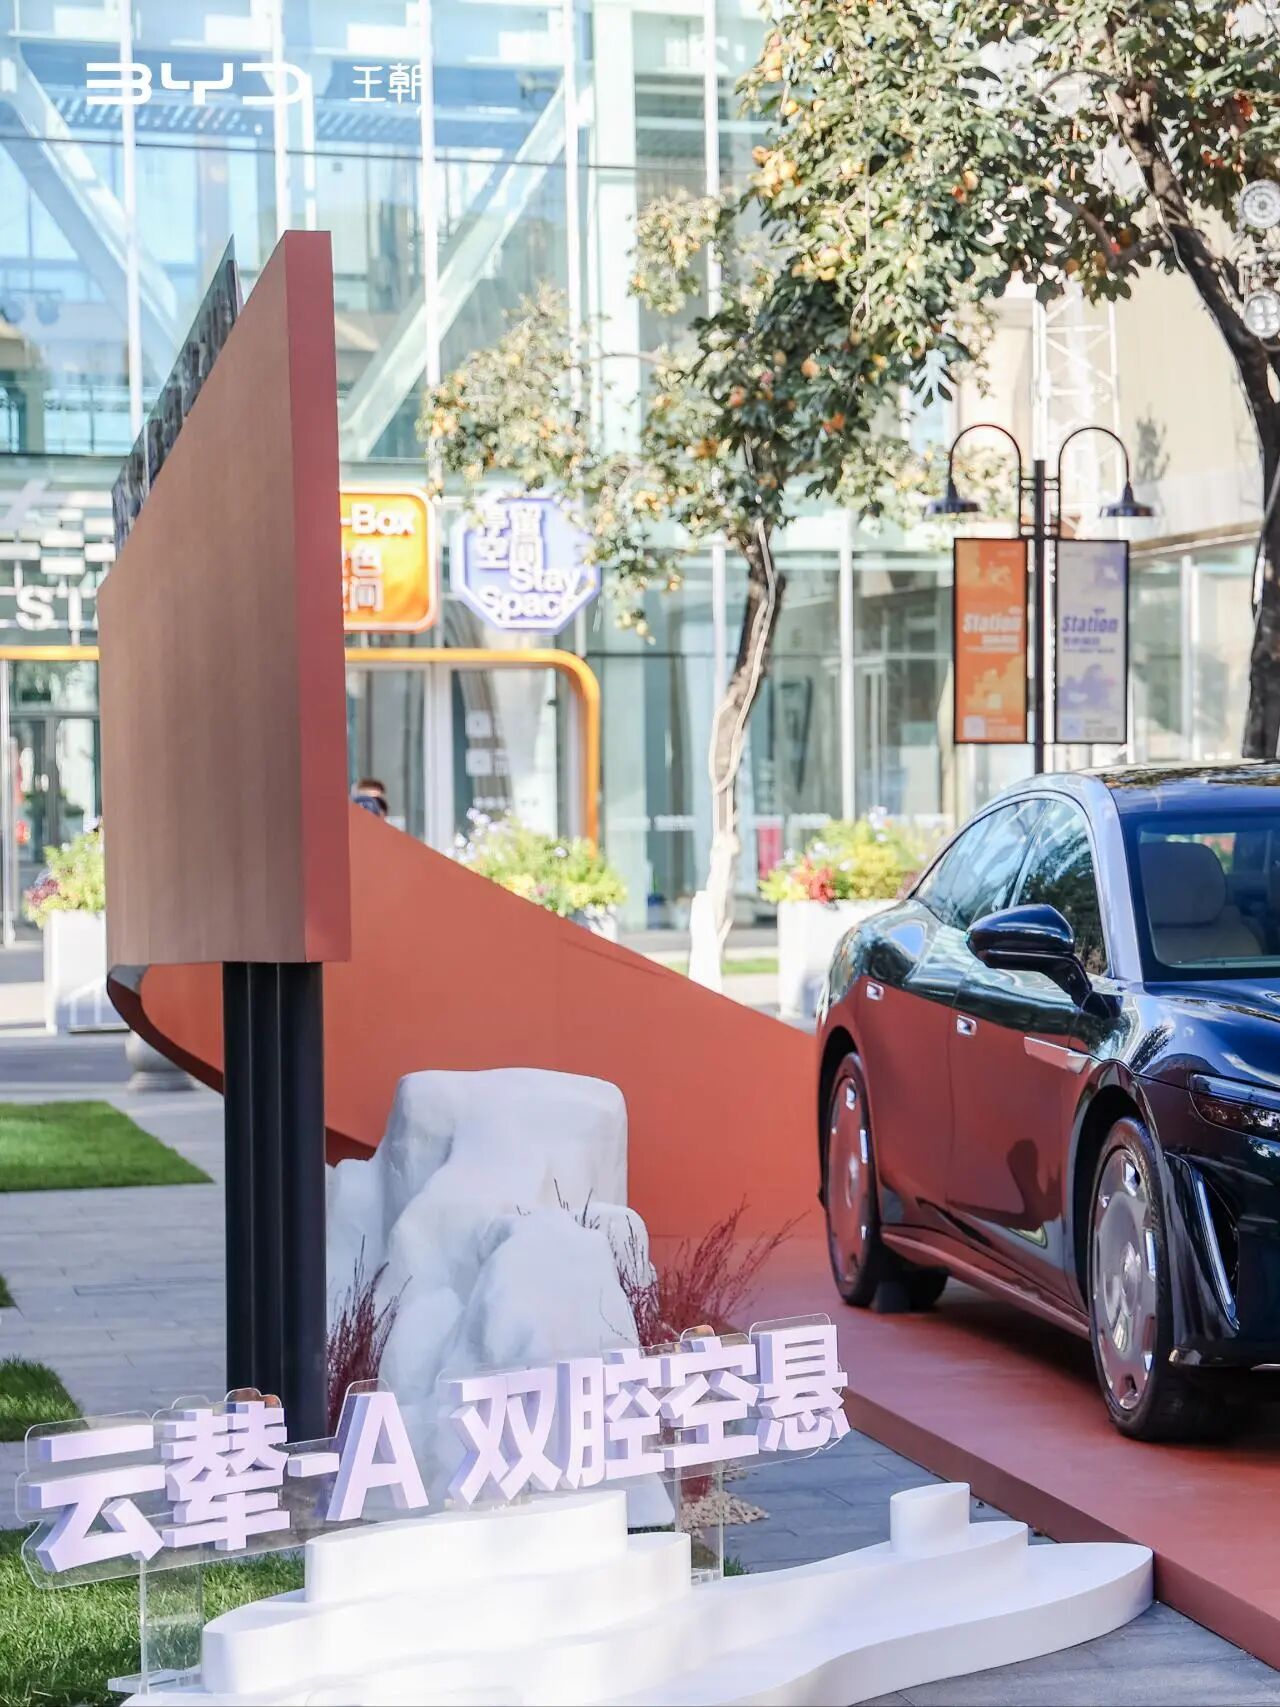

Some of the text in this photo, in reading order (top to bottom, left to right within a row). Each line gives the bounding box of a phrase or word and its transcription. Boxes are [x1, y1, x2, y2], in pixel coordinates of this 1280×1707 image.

[16, 584, 98, 631] ST
[1062, 613, 1119, 633] Station
[447, 1324, 851, 1505] 双腔空悬
